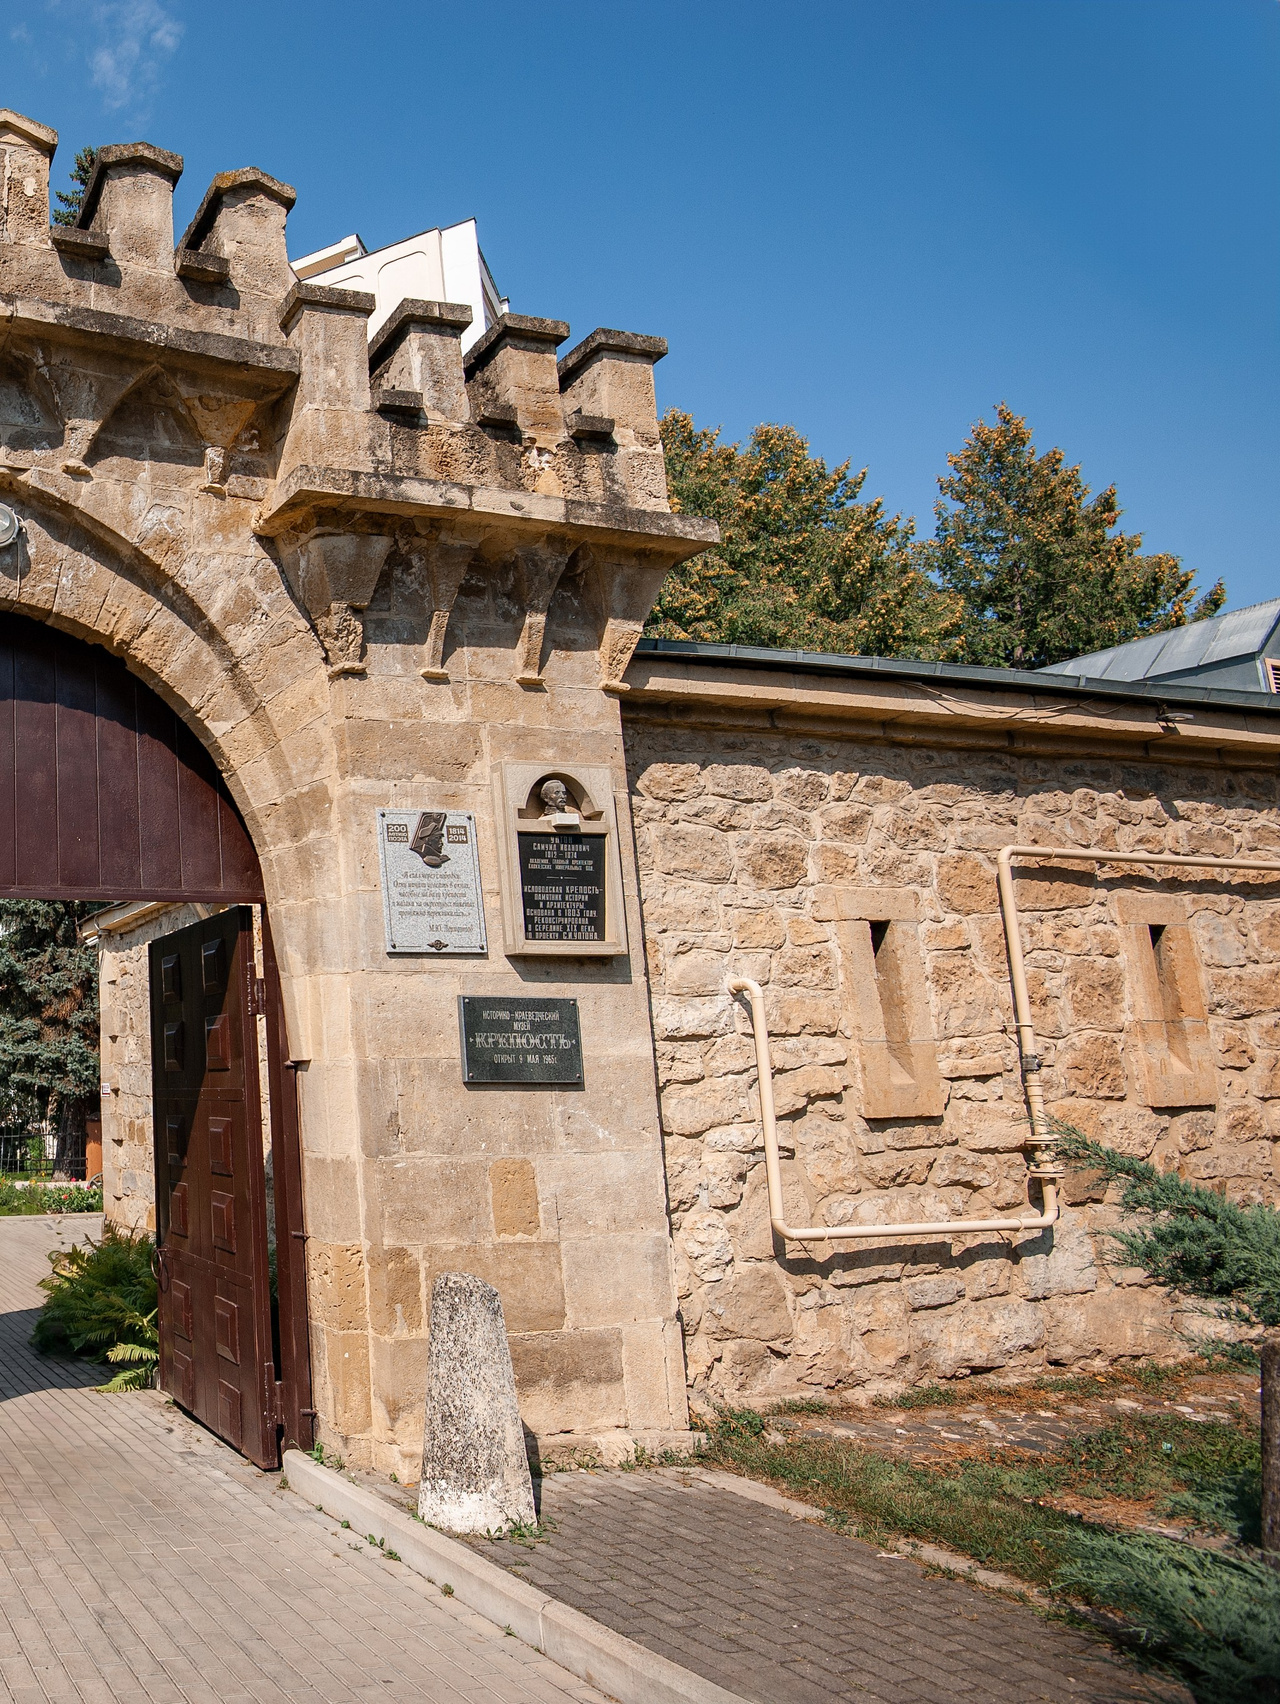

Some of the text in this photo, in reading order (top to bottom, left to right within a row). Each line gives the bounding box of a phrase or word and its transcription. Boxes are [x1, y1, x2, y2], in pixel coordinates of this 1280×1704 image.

[449, 827, 465, 835] 1814
[448, 834, 466, 842] 2014
[523, 885, 563, 893] ИСЛОВОДСКАЯ
[564, 909, 580, 917] 1803
[513, 1020, 531, 1031] МУЗЕЙ
[493, 1054, 516, 1064] ОТКРЫТ
[527, 1054, 540, 1064] МАЯ
